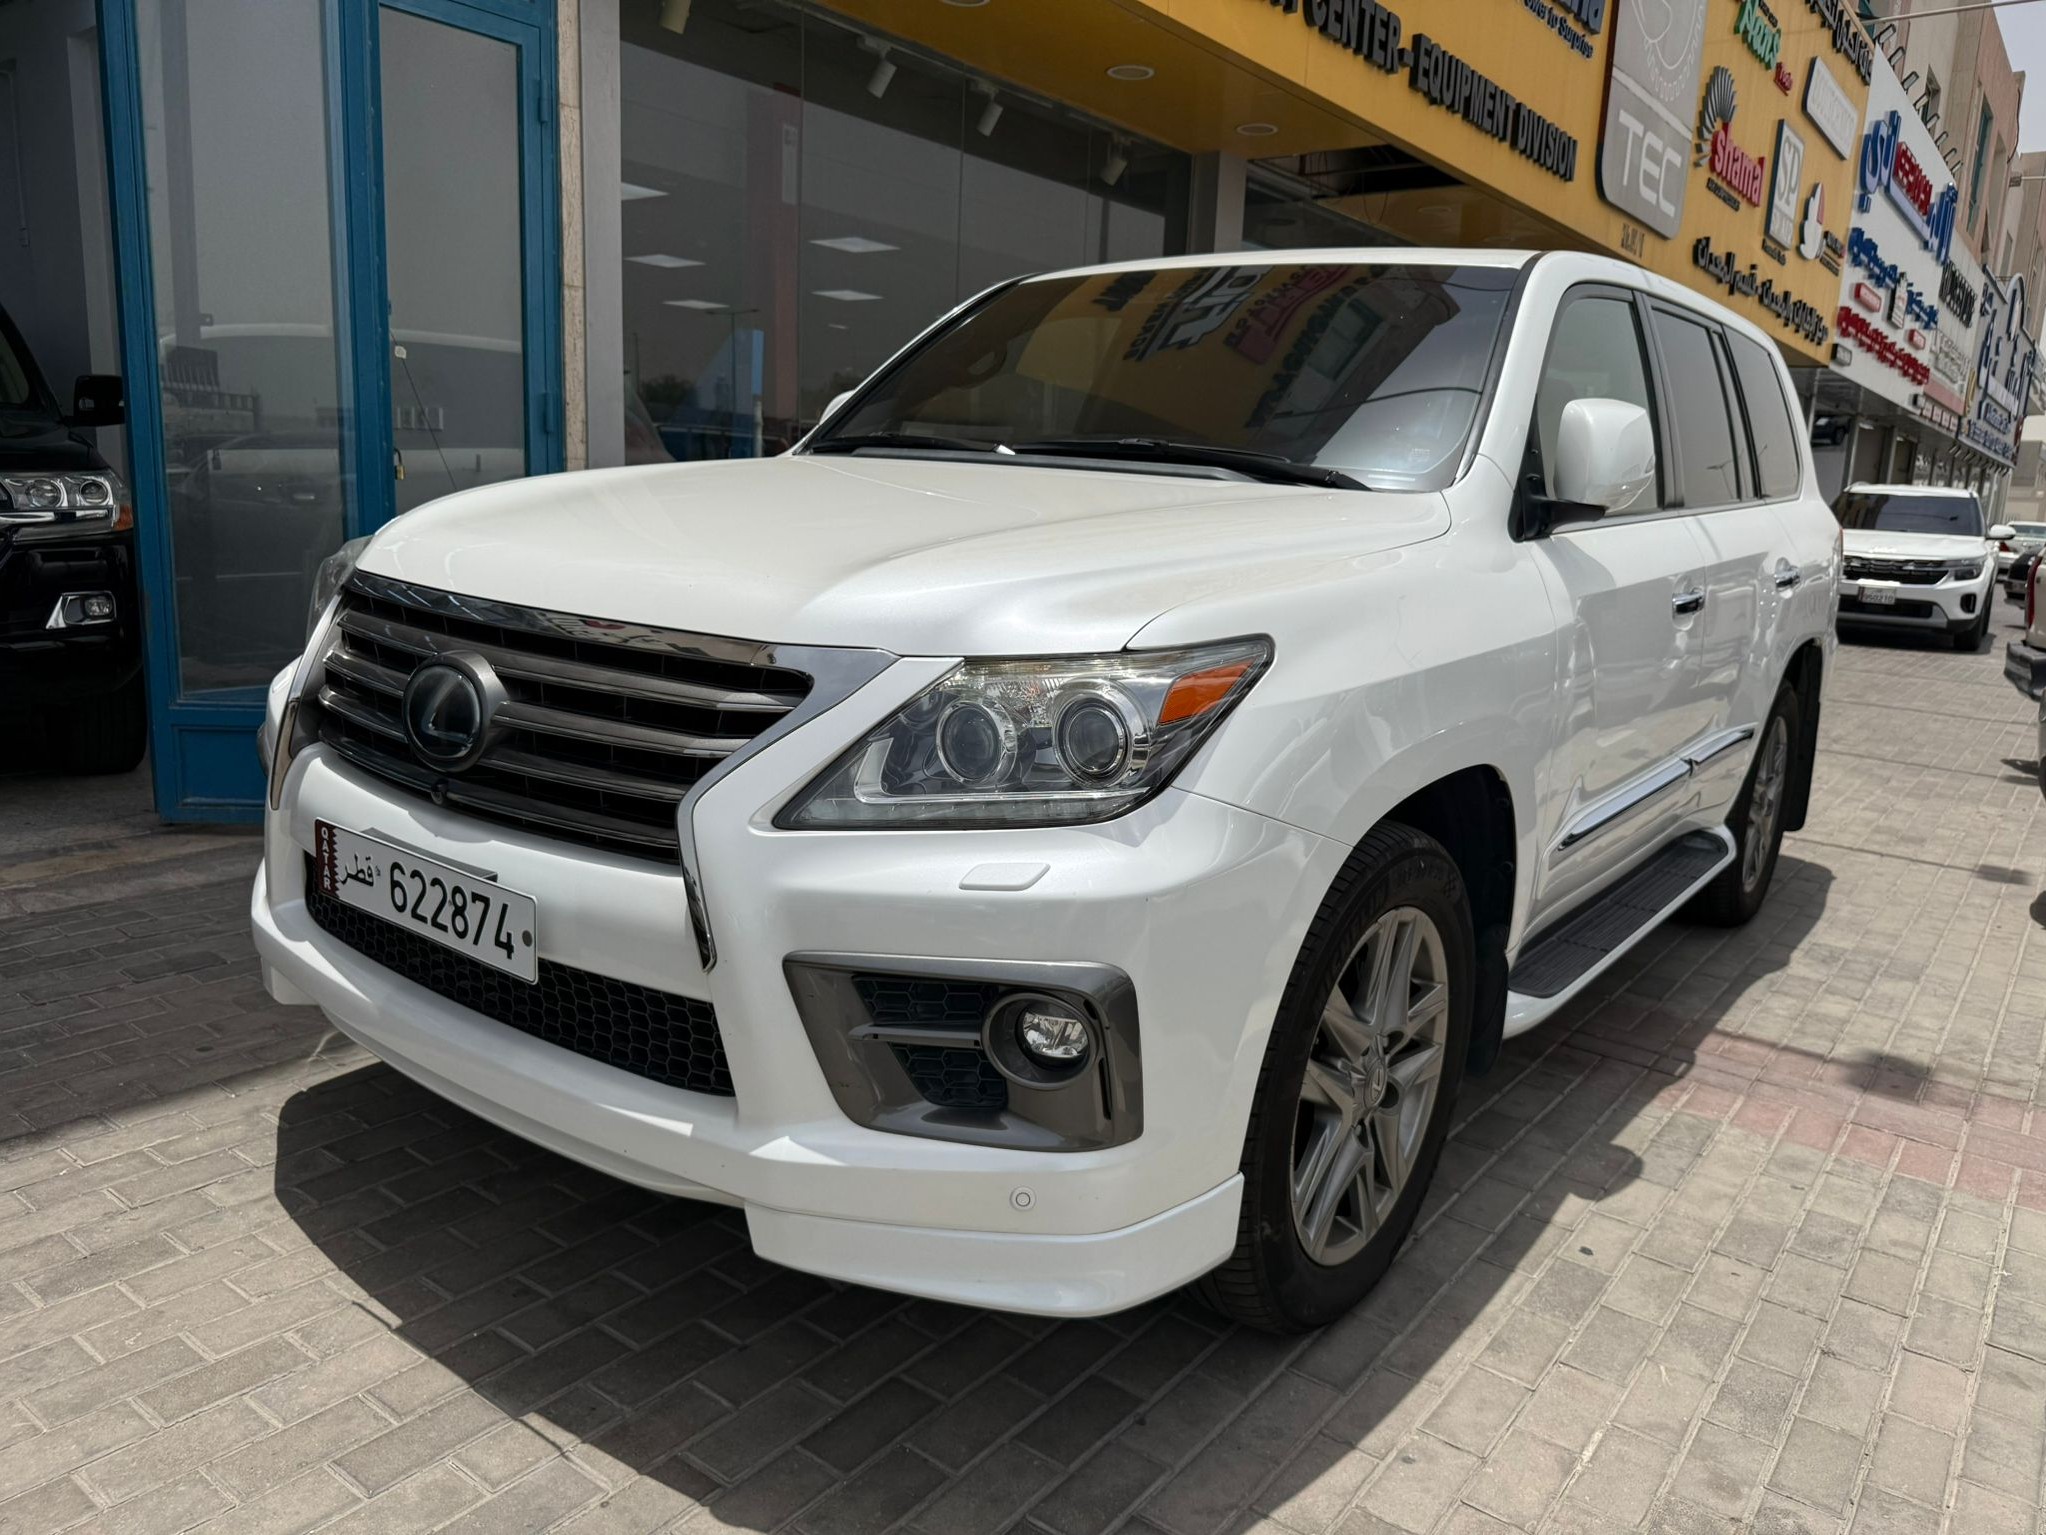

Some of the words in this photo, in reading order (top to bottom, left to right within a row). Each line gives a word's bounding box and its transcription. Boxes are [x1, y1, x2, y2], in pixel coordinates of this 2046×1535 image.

[1558, 15, 1594, 59] Surprise
[1409, 33, 1516, 143] EQUIPMENT
[1511, 102, 1578, 182] DIVISION
[1618, 110, 1682, 218] TEC
[321, 826, 332, 891] QATAR
[340, 853, 374, 888] قطر
[389, 861, 515, 960] 622874
